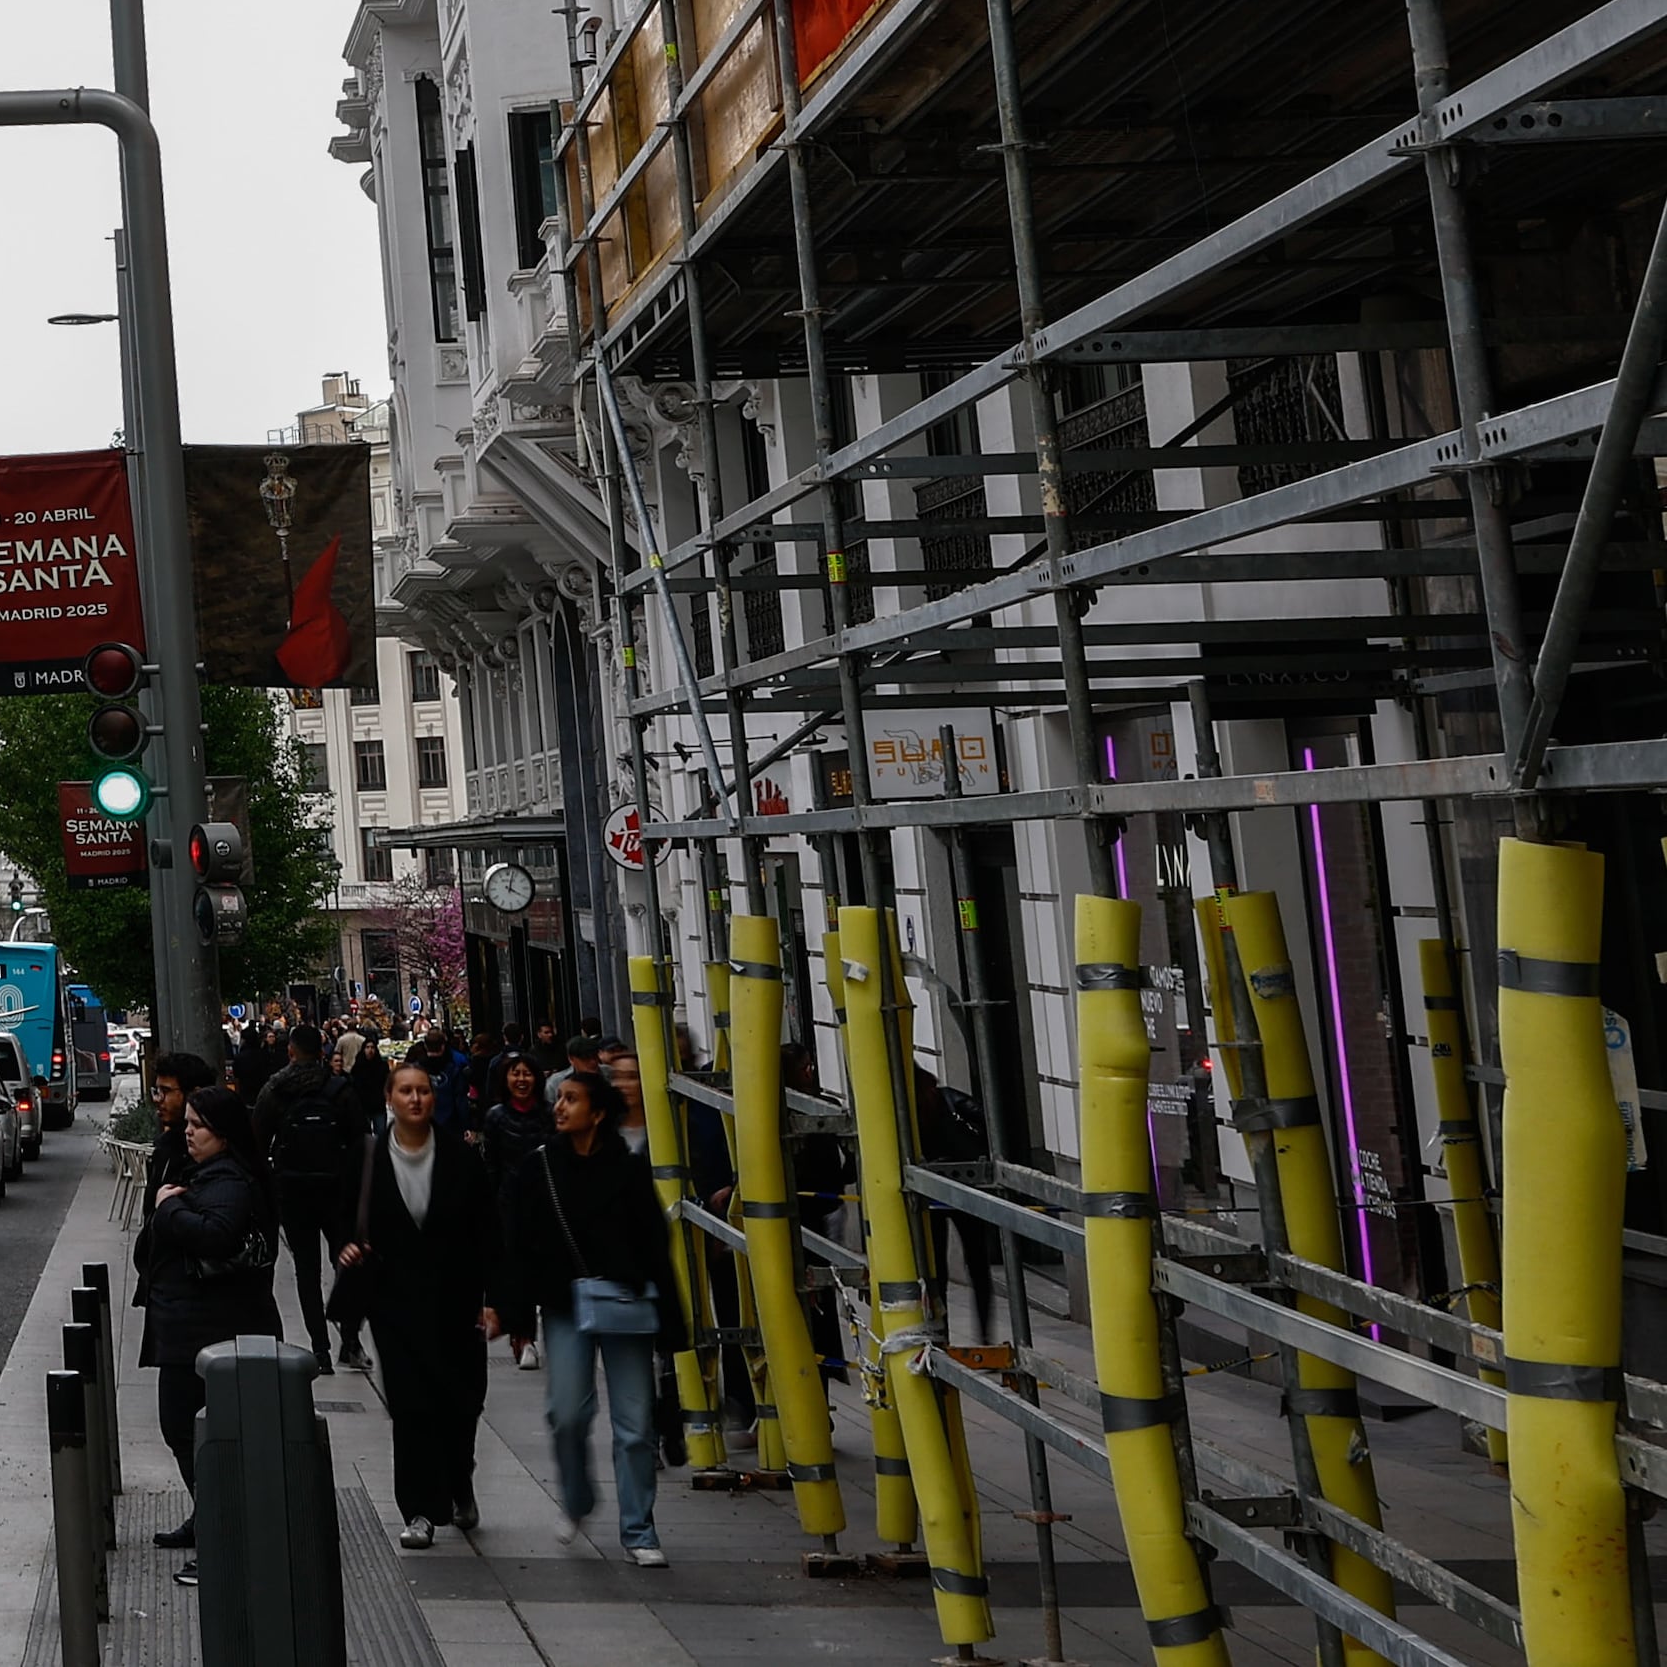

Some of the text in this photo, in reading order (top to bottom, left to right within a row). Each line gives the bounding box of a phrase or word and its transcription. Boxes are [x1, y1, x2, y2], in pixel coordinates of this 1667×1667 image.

[14, 512, 36, 524] 20
[42, 507, 95, 523] ABRIL
[66, 603, 108, 618] 2025
[35, 669, 85, 685] MADR
[66, 819, 139, 833] SEMANA
[75, 830, 132, 845] SANTA
[80, 848, 131, 857] MADRID 2025
